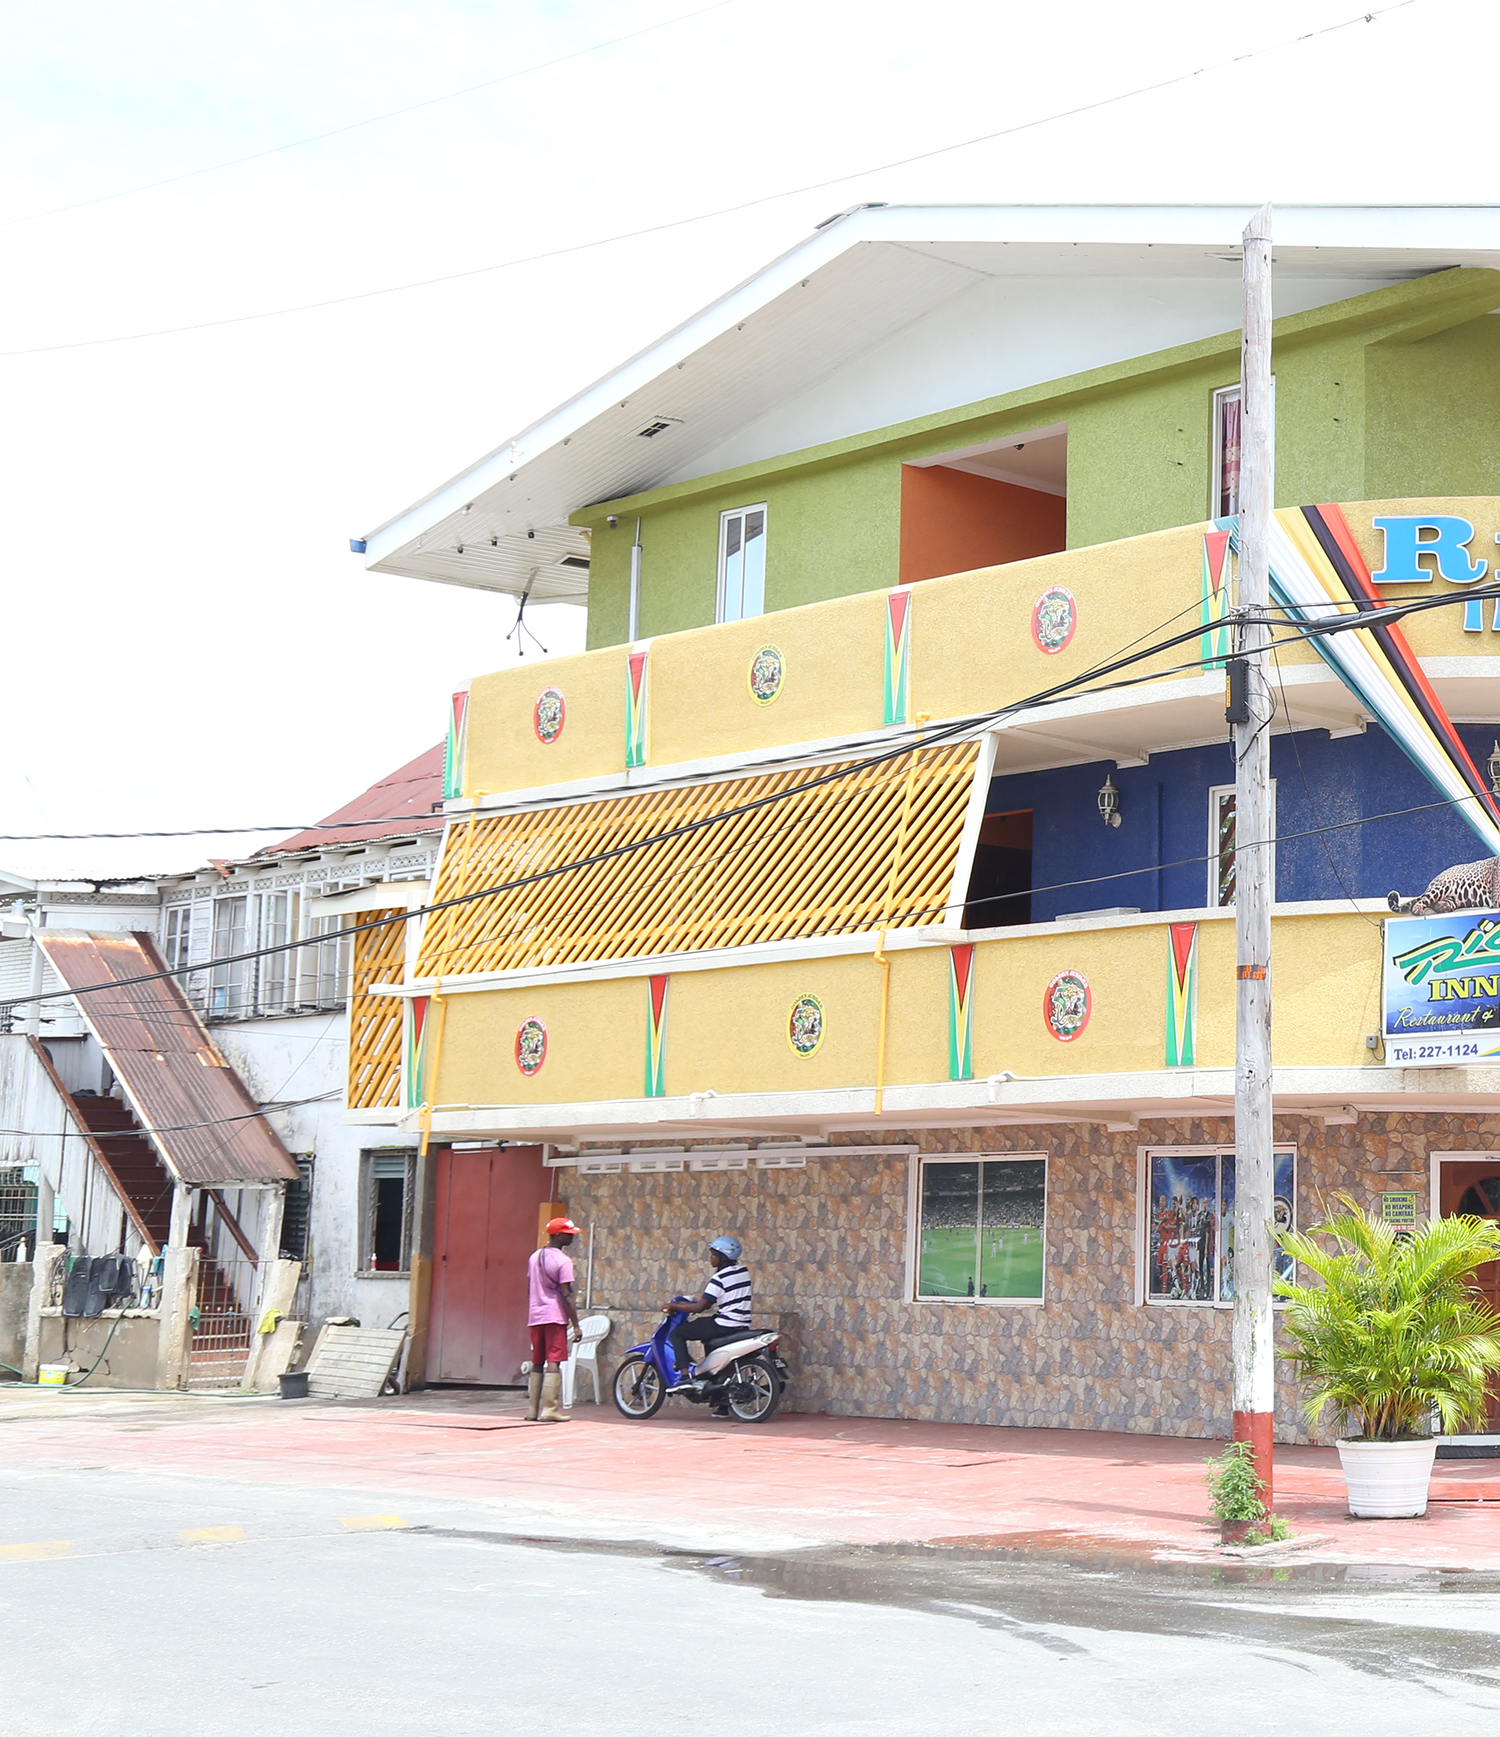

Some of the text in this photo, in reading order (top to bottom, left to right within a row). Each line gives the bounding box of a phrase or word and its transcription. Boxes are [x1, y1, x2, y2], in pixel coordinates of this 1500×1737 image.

[1428, 974, 1500, 1002] INN
[1394, 1006, 1480, 1028] Restaurant
[1394, 1043, 1479, 1061] Tel: 227-1124
